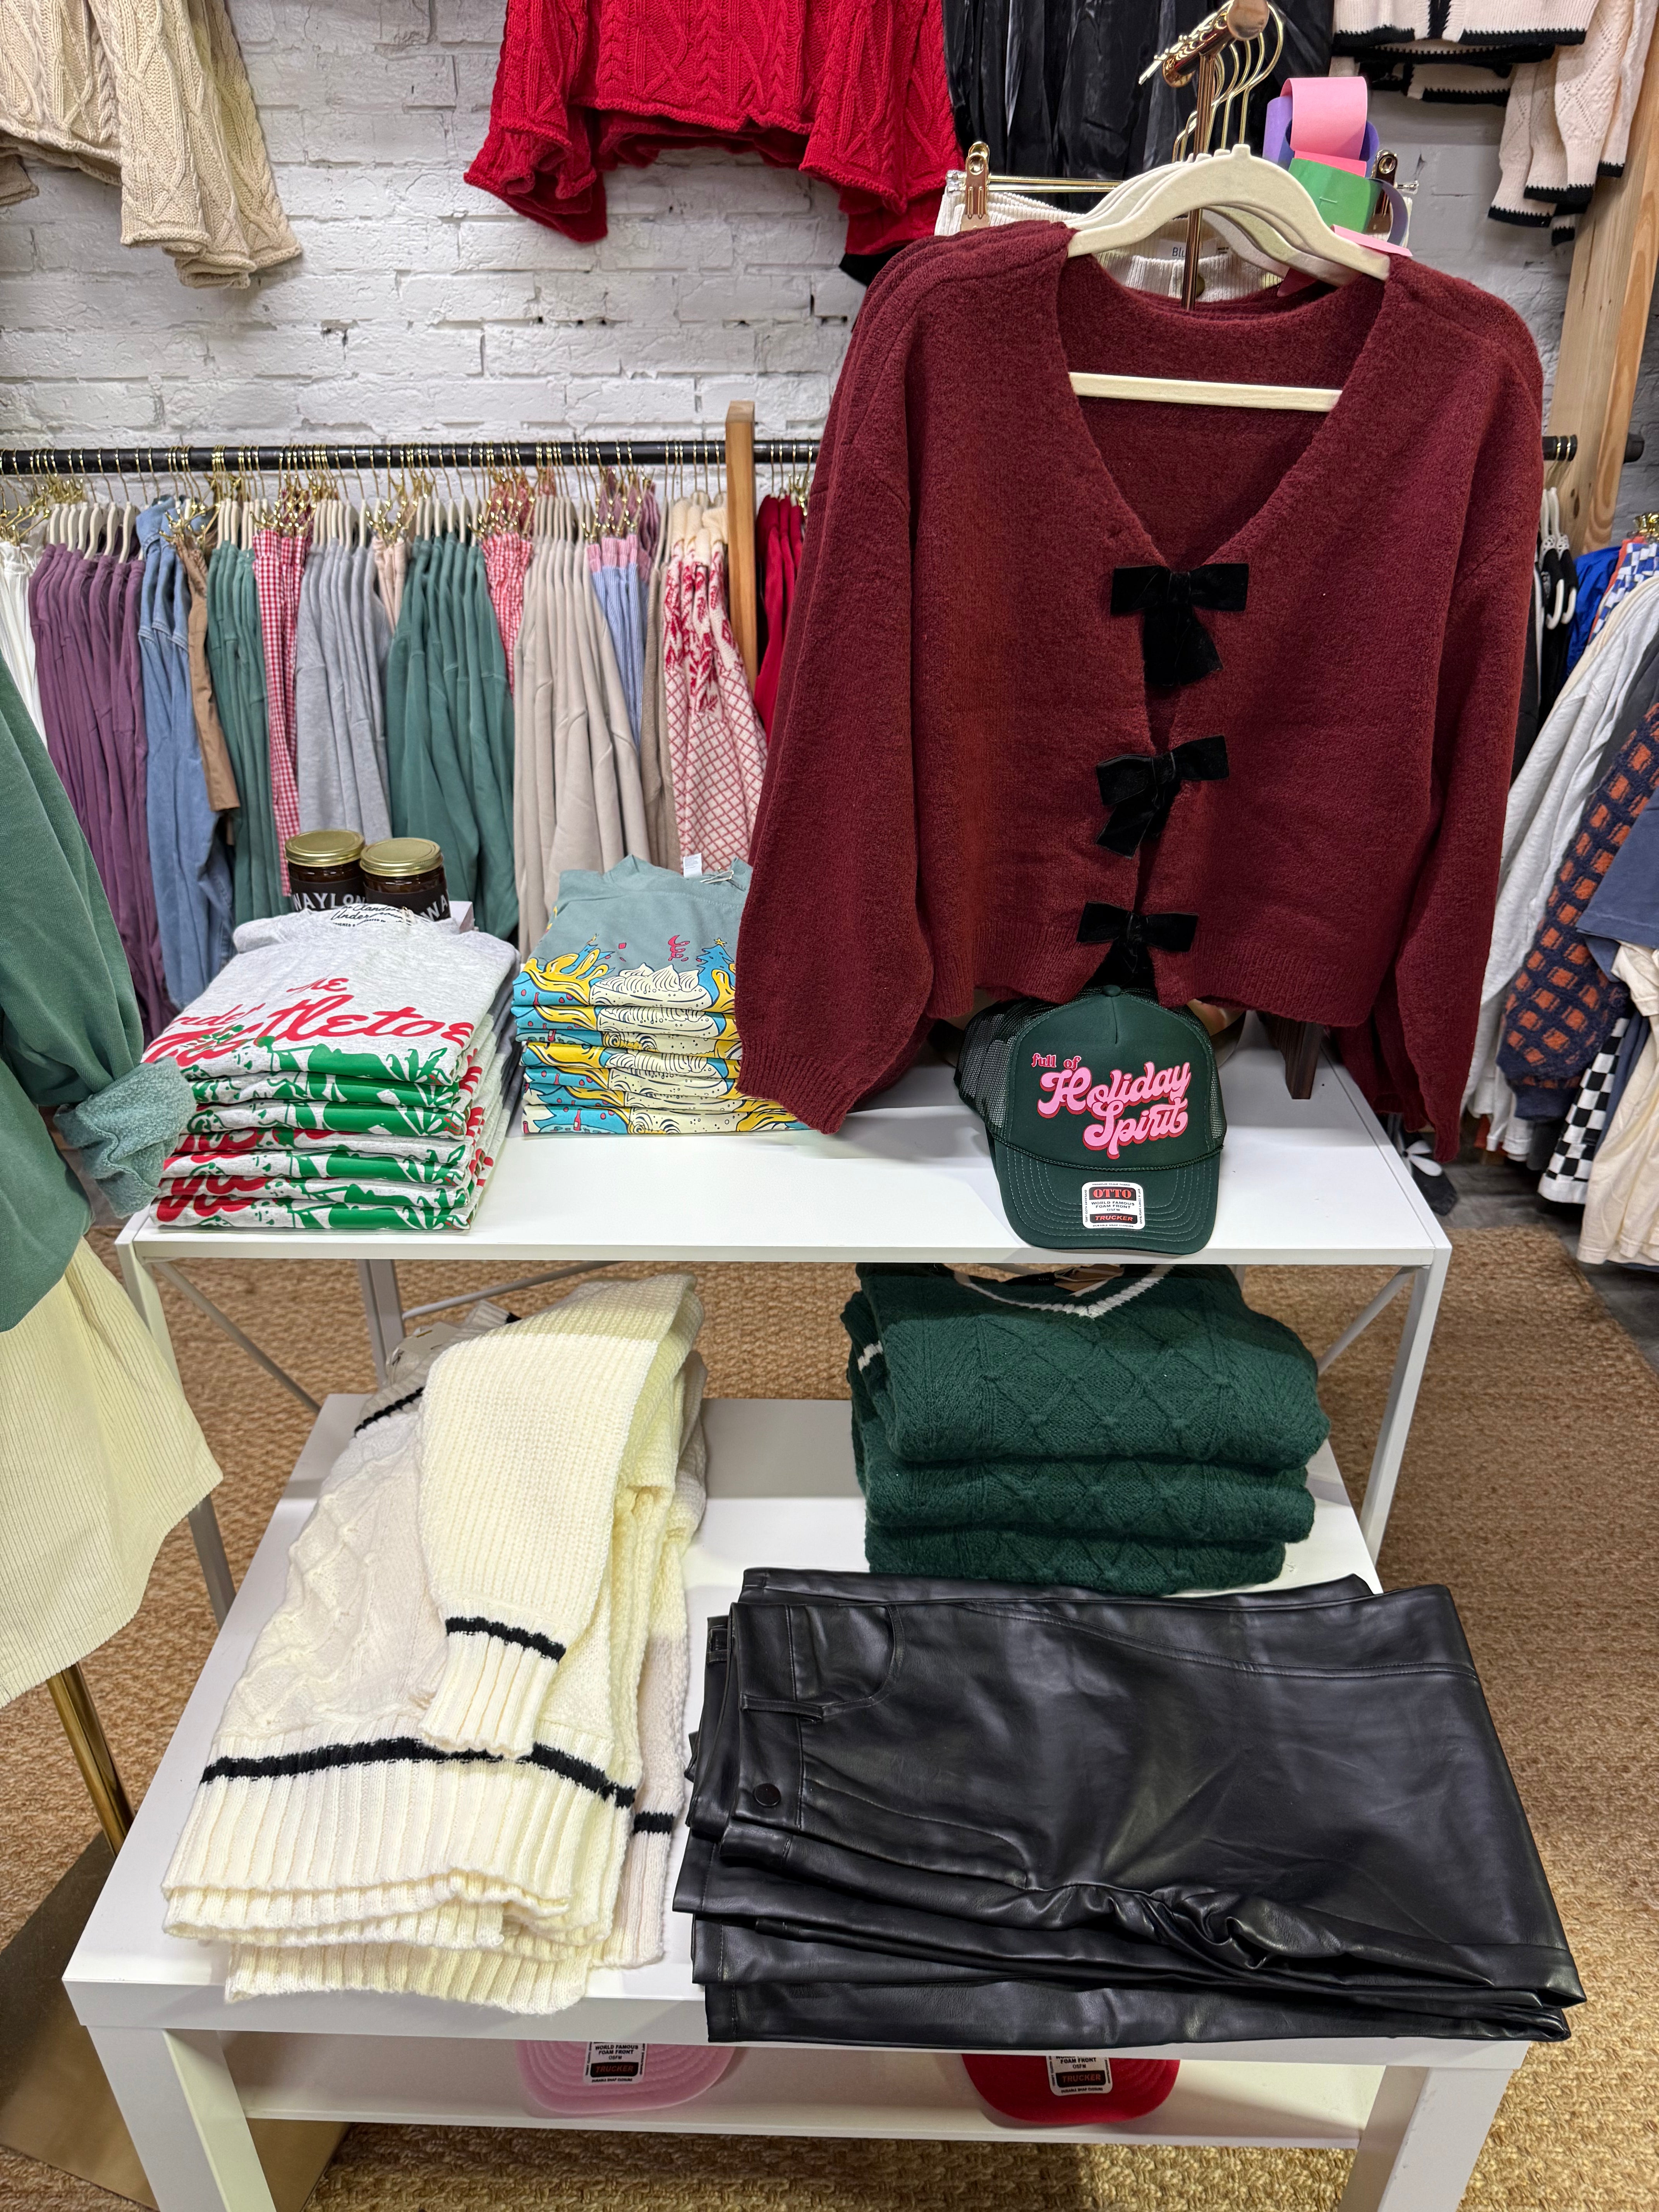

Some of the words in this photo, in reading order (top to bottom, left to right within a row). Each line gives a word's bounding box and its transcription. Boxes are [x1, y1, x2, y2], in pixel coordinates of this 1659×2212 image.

[293, 893, 366, 911] WAYLON
[1031, 1053, 1056, 1068] full
[1063, 1056, 1082, 1071] of
[1037, 1061, 1191, 1118] Holiday
[1083, 1096, 1188, 1159] Spirit
[1093, 1189, 1132, 1199] OTTO
[1062, 2073, 1101, 2083] TRUCKER
